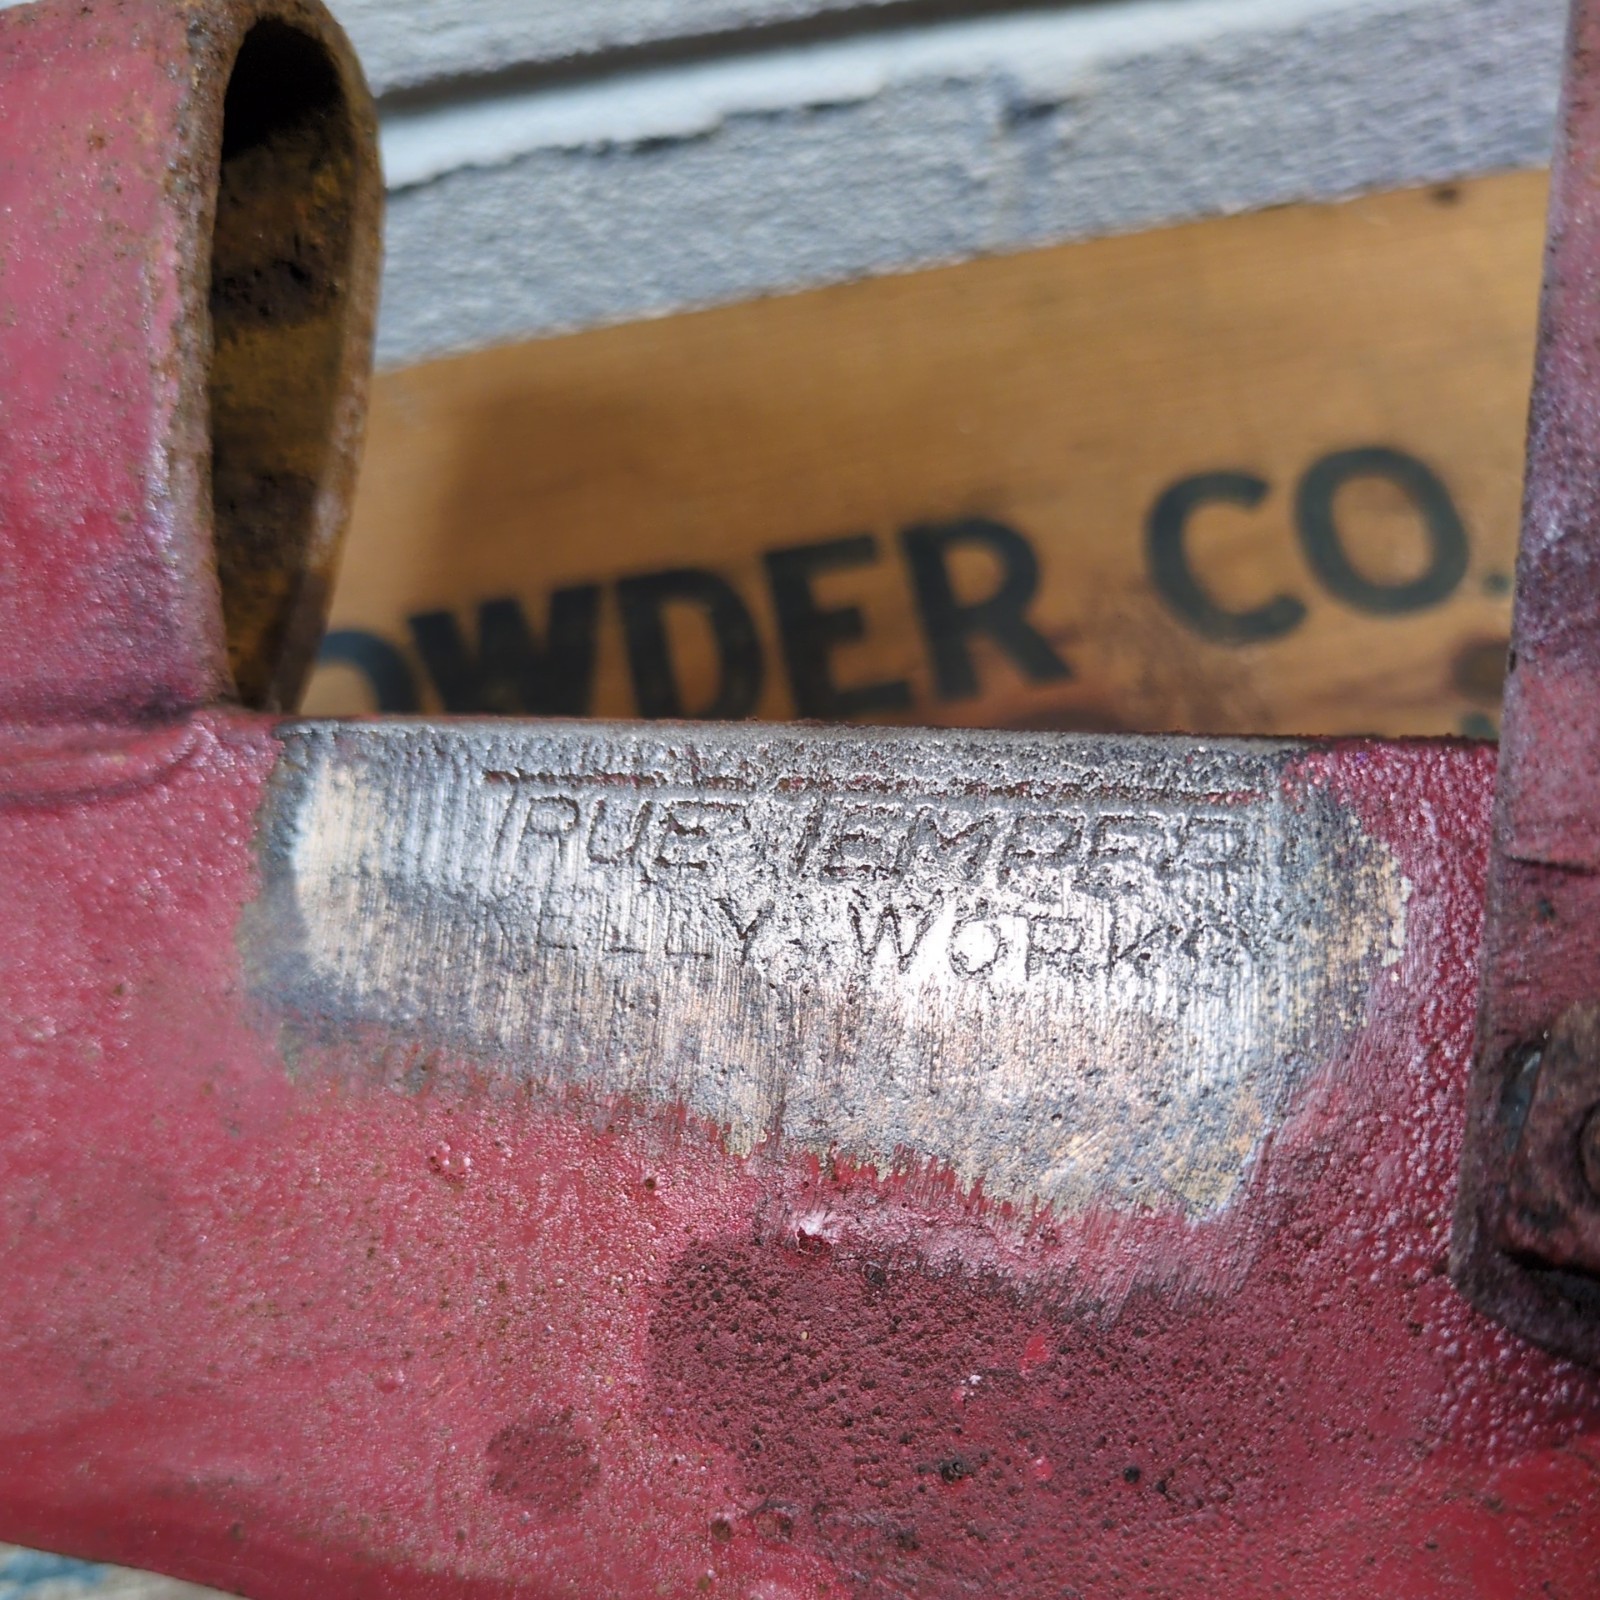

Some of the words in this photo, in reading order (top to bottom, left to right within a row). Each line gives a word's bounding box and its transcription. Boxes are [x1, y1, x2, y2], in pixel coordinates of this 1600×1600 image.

[1143, 446, 1511, 644] CO.
[484, 771, 757, 869] TRUE
[777, 776, 1254, 890] TEMPER
